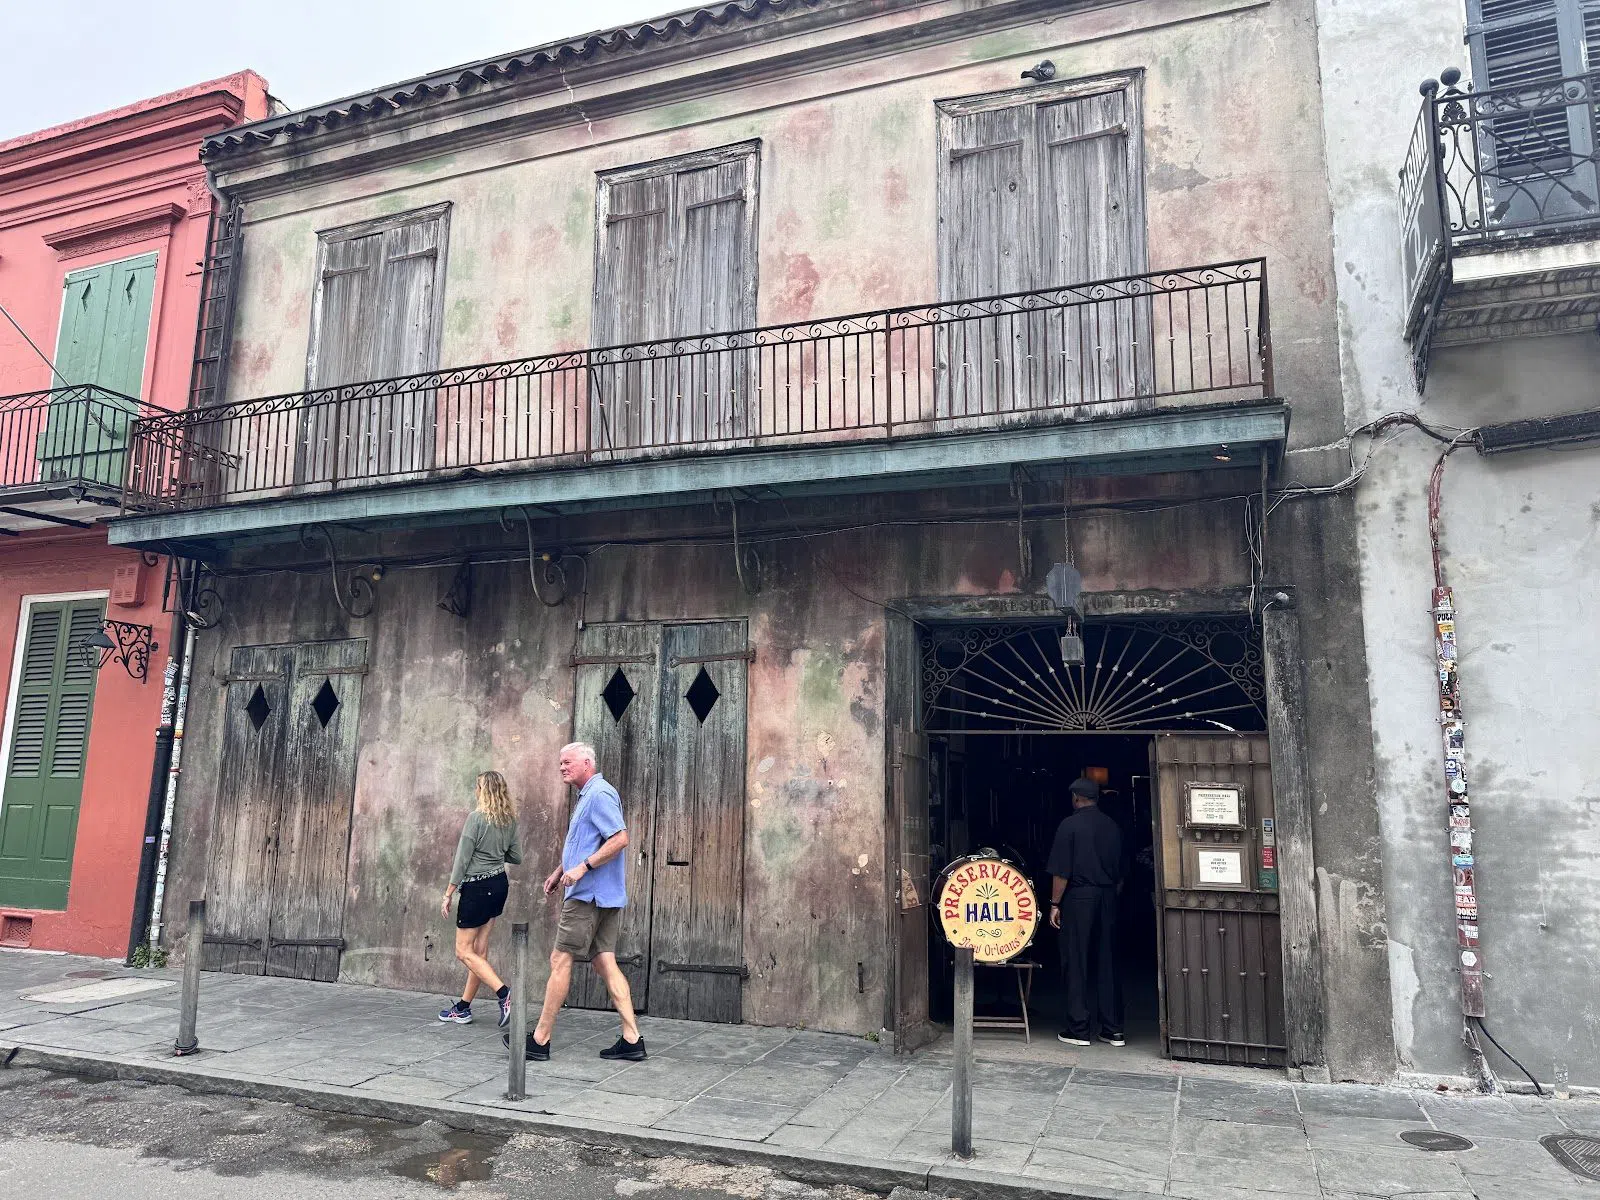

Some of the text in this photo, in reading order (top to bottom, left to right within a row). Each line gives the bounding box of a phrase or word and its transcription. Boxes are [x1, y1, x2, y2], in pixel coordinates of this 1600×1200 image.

[944, 863, 1033, 922] PRESERVATION
[965, 901, 1014, 923] HALL
[984, 937, 1021, 956] Orleans
